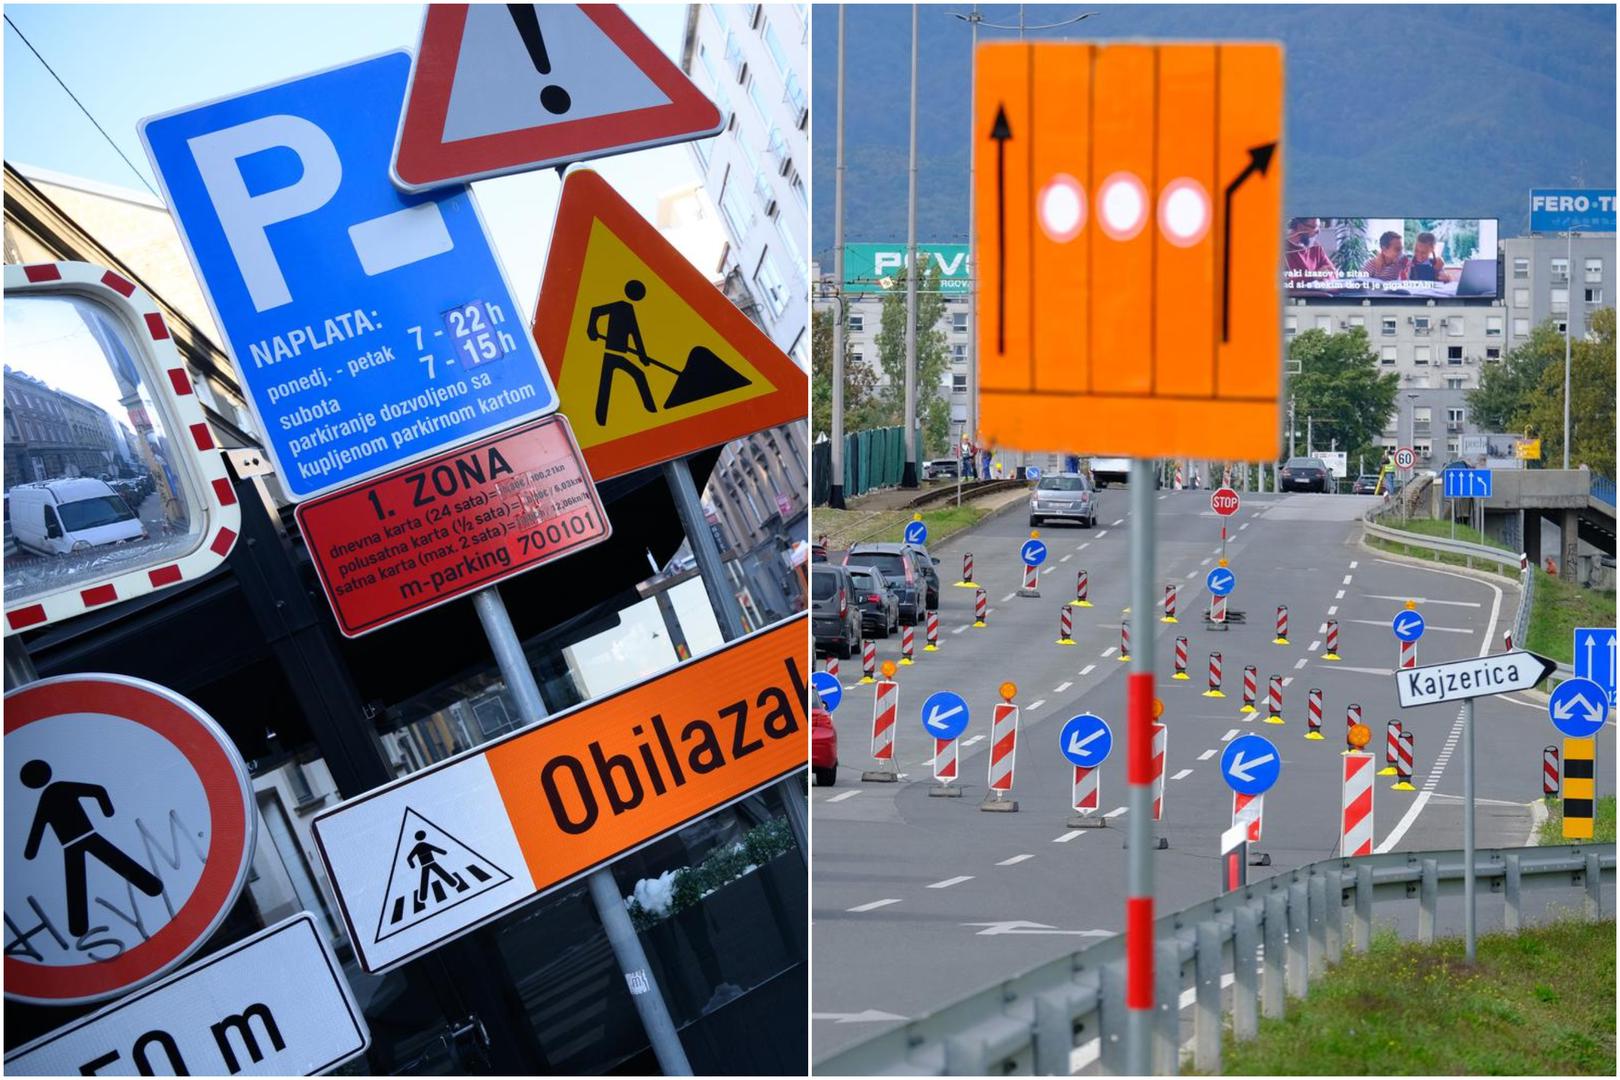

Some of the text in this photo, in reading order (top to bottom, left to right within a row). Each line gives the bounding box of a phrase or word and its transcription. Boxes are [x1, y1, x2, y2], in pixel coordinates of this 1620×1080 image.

[187, 114, 343, 313] P
[249, 309, 383, 369] NAPLATA:
[267, 367, 332, 404] ponedj.
[347, 345, 396, 377] petak
[407, 326, 423, 351] 7
[450, 305, 485, 338] 22
[485, 302, 505, 326] h
[280, 398, 342, 430] subota
[419, 355, 436, 379] 7
[463, 333, 497, 364] 15
[498, 331, 517, 354] h
[289, 372, 492, 457] parkiranje dozvoljeno sa
[297, 383, 536, 480] kupljenom parkirnom kartom
[1398, 454, 1412, 465] 60
[368, 446, 514, 521] 1. ZONA
[1213, 496, 1238, 509] STOP
[329, 531, 381, 559] dnevna
[384, 515, 423, 540] karta
[425, 506, 452, 528] (24
[335, 574, 377, 596] satna
[379, 559, 418, 580] karta
[418, 542, 460, 568] (max.
[459, 535, 471, 549] 2
[338, 547, 409, 577] polusatna
[411, 527, 450, 550] karta
[400, 511, 596, 599] m-parking 700101
[1409, 663, 1519, 699] Kajzerica
[210, 1003, 287, 1076] m
